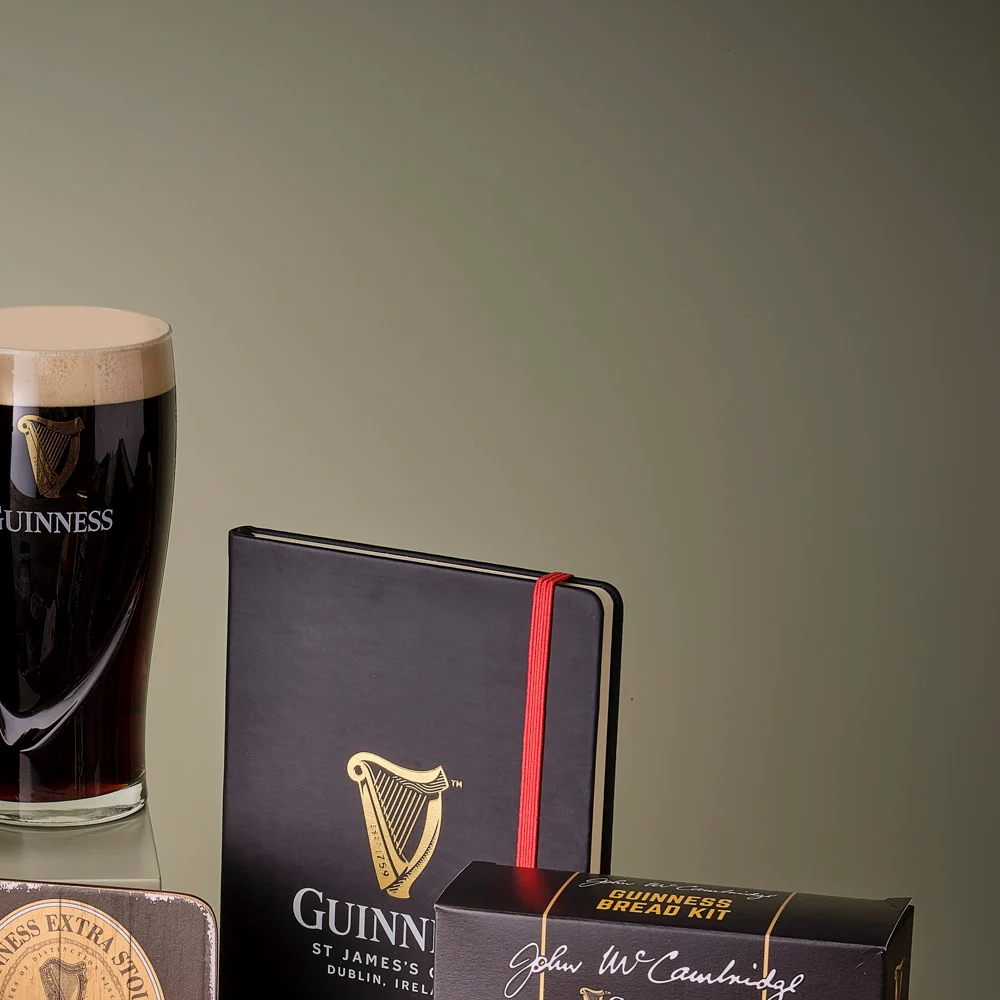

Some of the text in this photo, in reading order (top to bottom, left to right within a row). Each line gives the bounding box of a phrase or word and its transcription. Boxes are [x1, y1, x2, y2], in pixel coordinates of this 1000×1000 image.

[596, 899, 732, 920] BREAD KIT
[608, 889, 732, 908] GUINNESS
[44, 914, 114, 954] EXTRA
[292, 887, 434, 954] GUINN
[312, 943, 333, 957] ST
[342, 948, 420, 976] JAMES'S
[504, 942, 582, 998] John
[327, 964, 434, 996] DUBLIN, IREL
